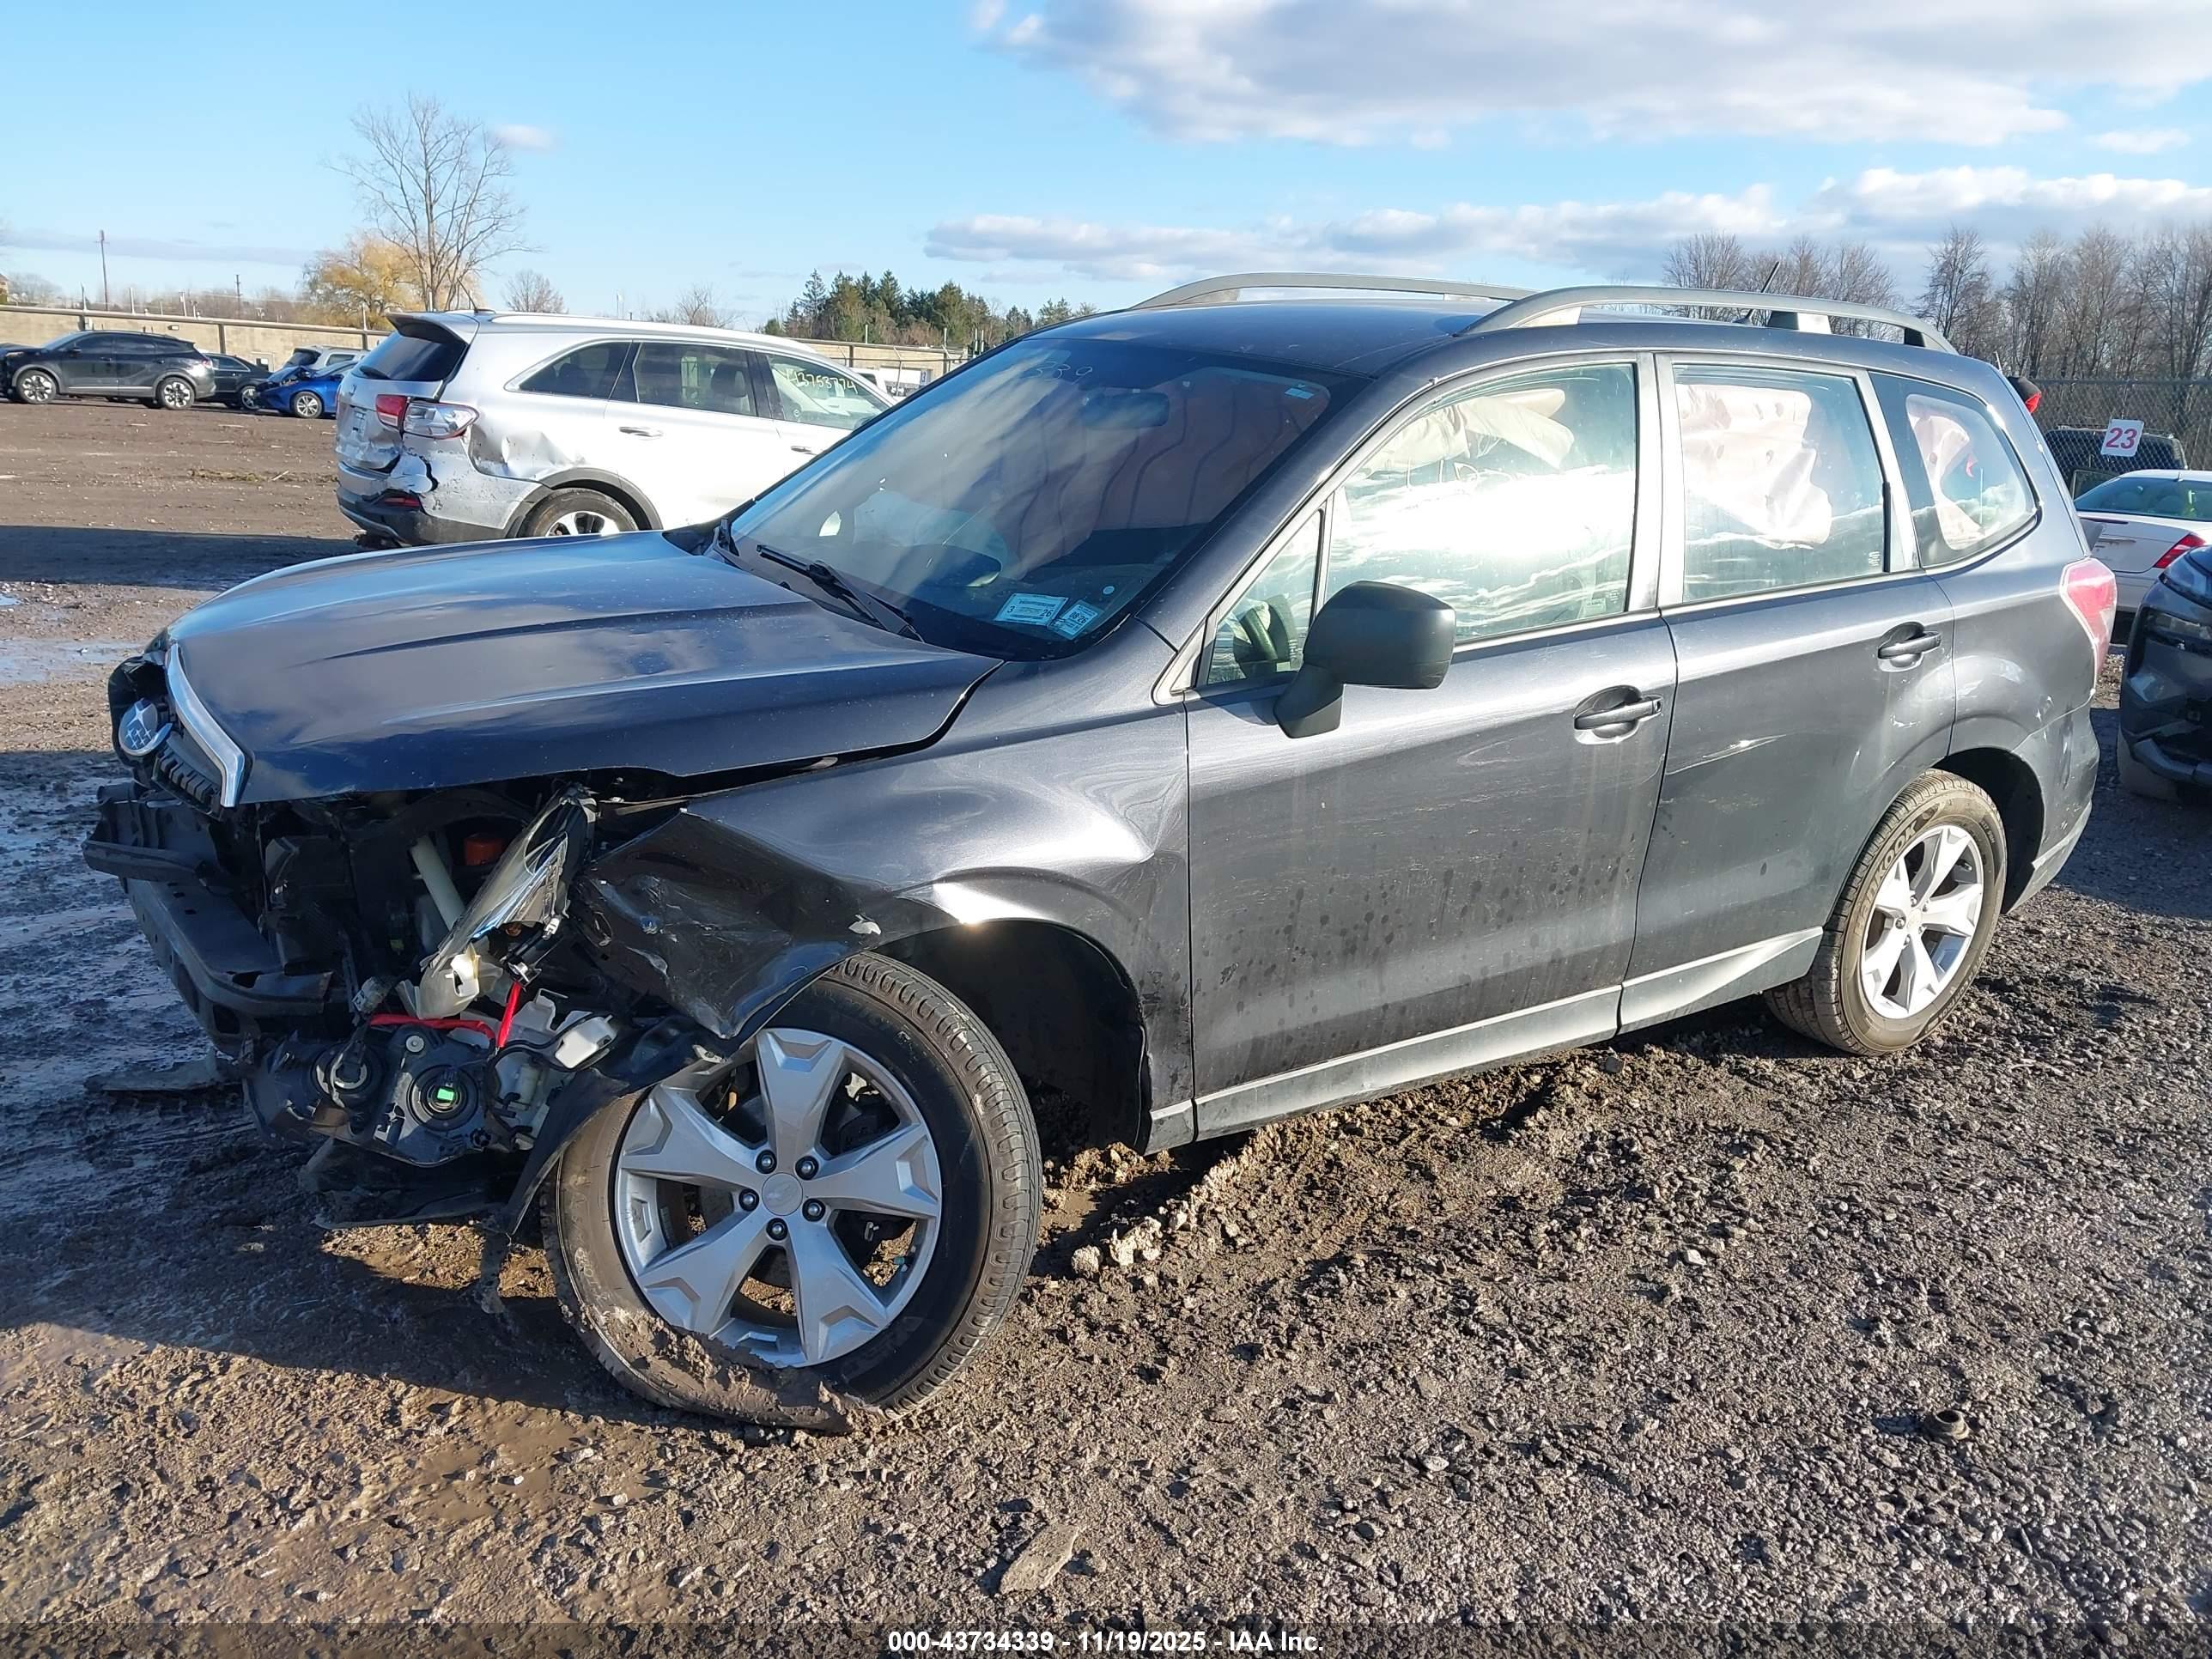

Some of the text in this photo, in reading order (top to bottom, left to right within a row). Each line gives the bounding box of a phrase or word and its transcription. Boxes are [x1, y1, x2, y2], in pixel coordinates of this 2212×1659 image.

[786, 368, 859, 394] 43753774
[2106, 427, 2138, 449] 23
[1039, 609, 1053, 618] 26
